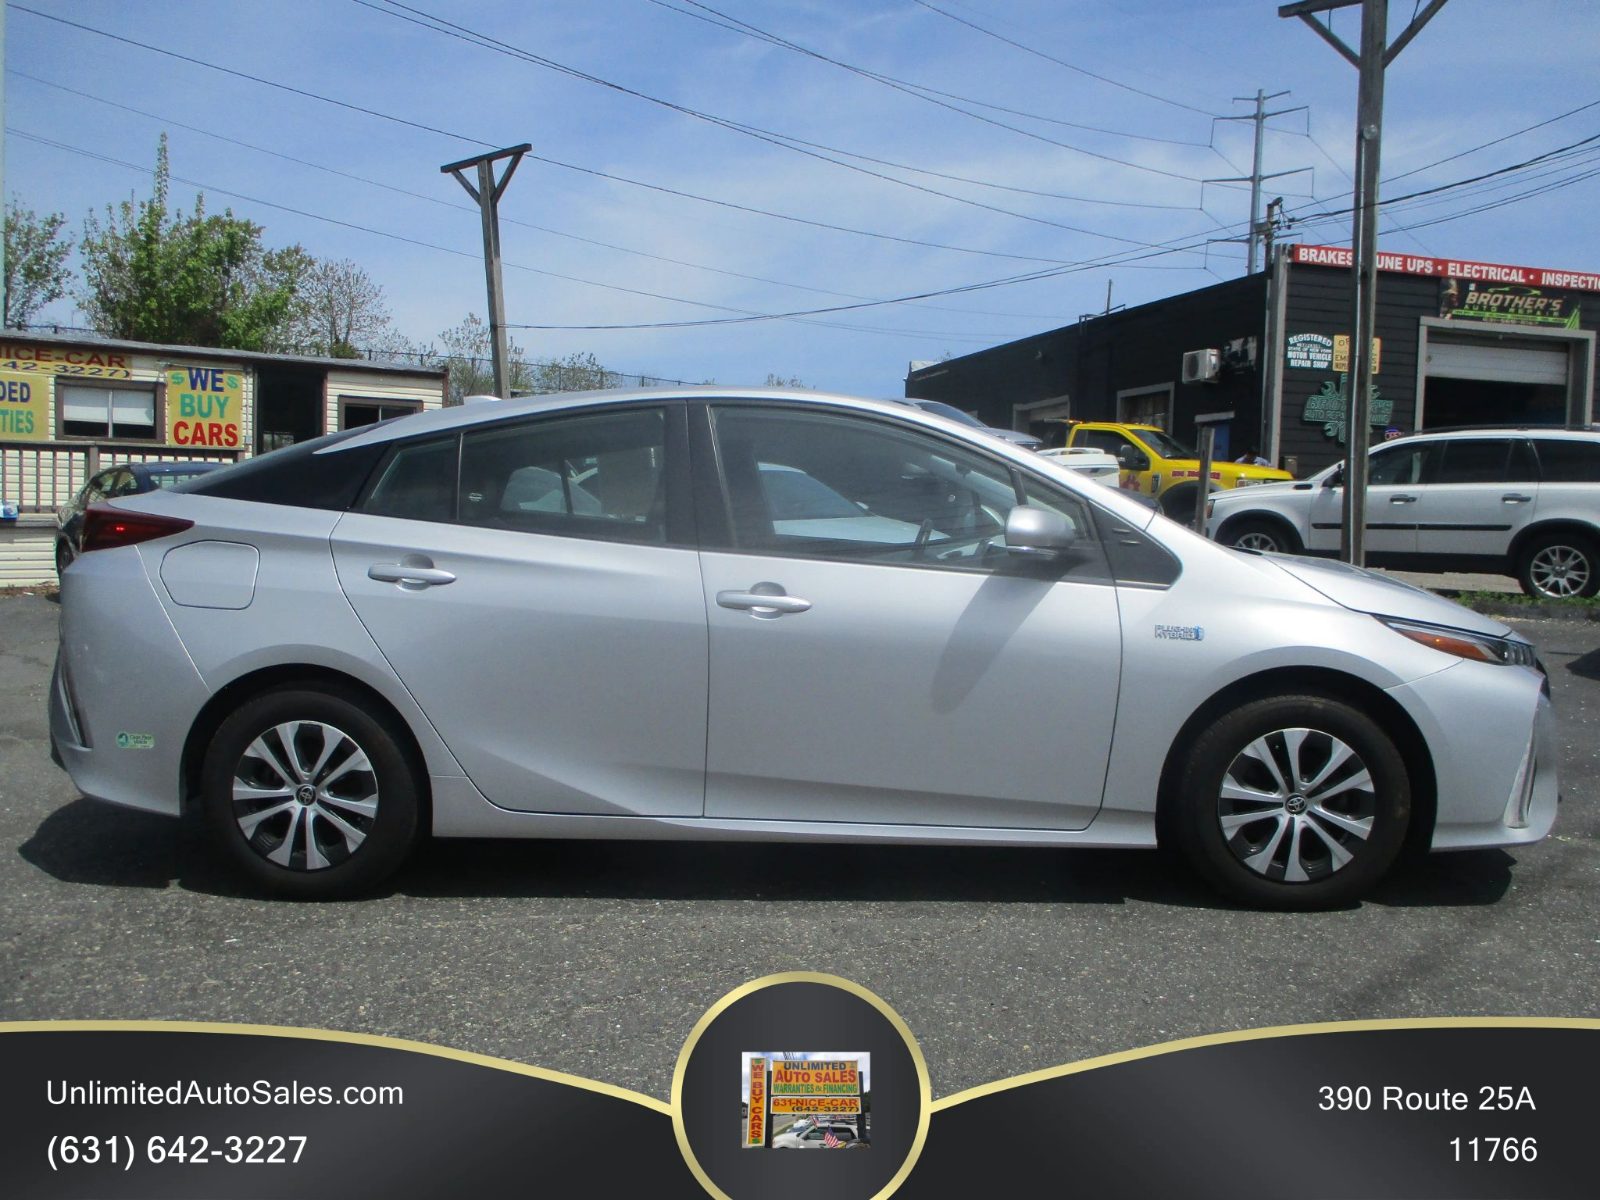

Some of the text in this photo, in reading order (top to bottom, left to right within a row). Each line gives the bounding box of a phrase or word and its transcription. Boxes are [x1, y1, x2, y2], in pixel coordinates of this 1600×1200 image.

[1299, 247, 1353, 266] BRAKES
[1376, 254, 1403, 271] UNE
[1407, 258, 1433, 274] UPS
[1447, 262, 1526, 283] ELECTRICAL
[1465, 291, 1563, 312] BROTHER'S
[1288, 333, 1333, 347] REGISTERED
[0, 345, 126, 368] ICE-CAR
[1287, 351, 1332, 361] MOTOR VEHICLE
[1290, 359, 1329, 369] REPAIR SHOP
[188, 367, 224, 392] WE
[180, 394, 230, 418] BUY
[0, 409, 34, 434] TIES
[173, 421, 239, 447] CARS
